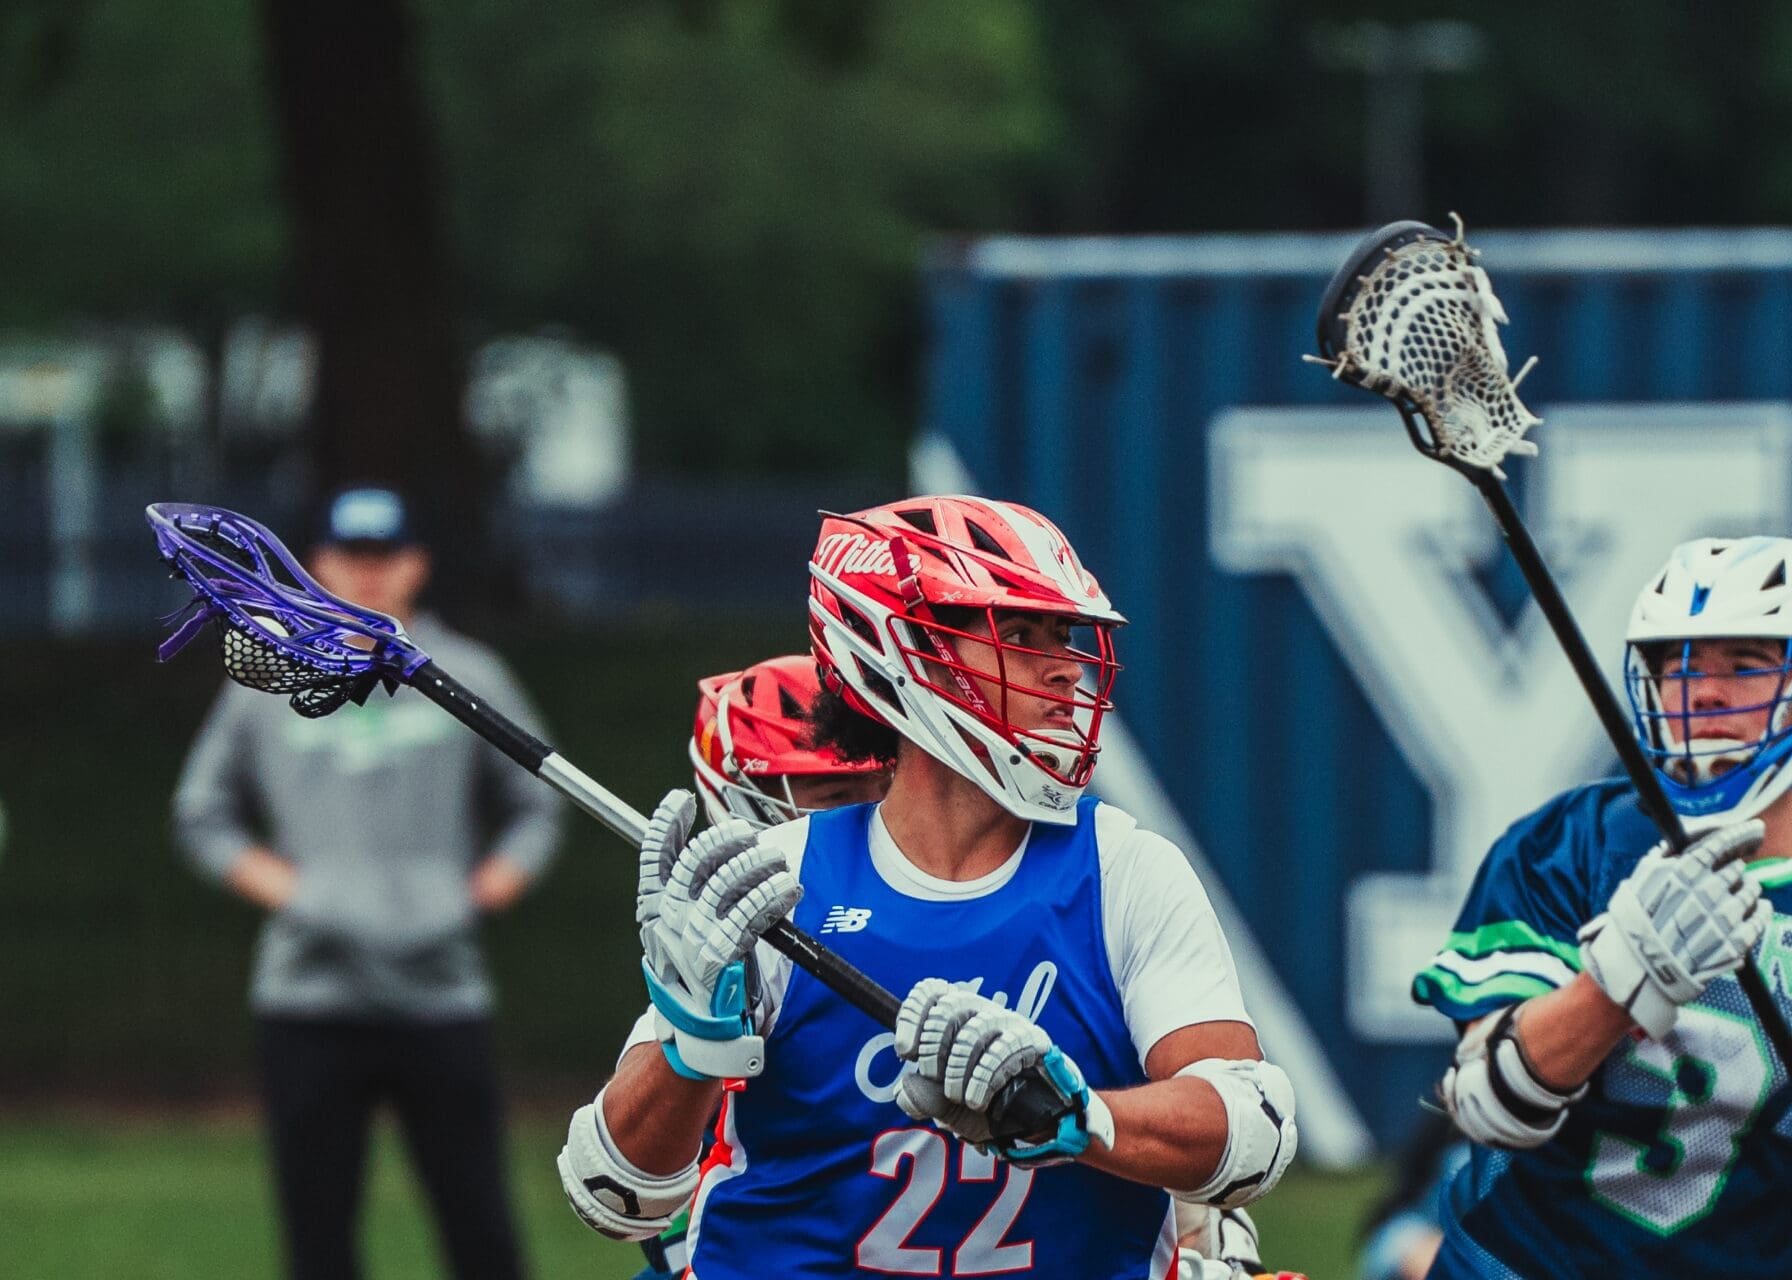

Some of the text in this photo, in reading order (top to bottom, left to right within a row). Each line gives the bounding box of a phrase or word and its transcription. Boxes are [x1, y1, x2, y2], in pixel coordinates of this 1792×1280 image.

[1210, 405, 1792, 1040] Y
[820, 905, 872, 933] NB
[856, 1128, 1035, 1276] 22
